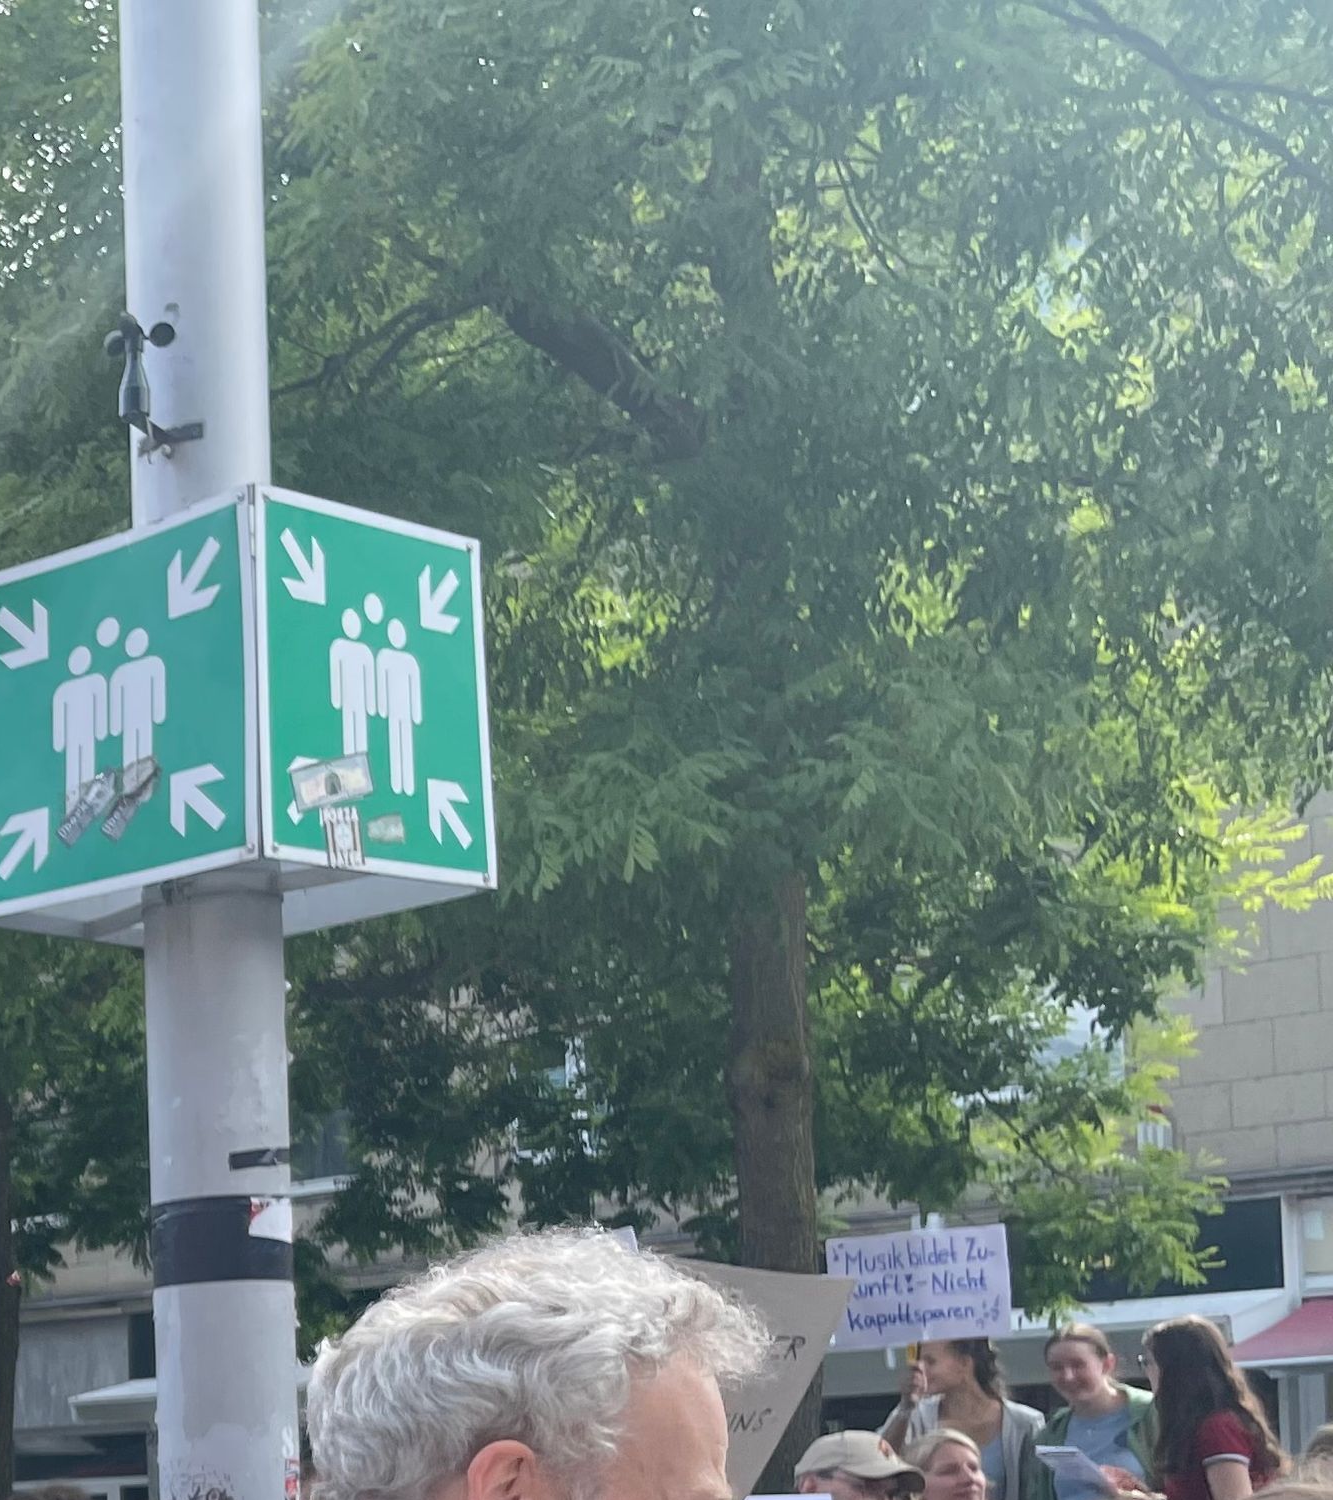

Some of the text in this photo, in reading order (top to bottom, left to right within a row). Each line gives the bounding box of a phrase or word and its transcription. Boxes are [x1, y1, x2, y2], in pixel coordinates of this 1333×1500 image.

[845, 1242, 904, 1275] Musik
[906, 1236, 957, 1267] bildet
[932, 1268, 987, 1295] Nicht
